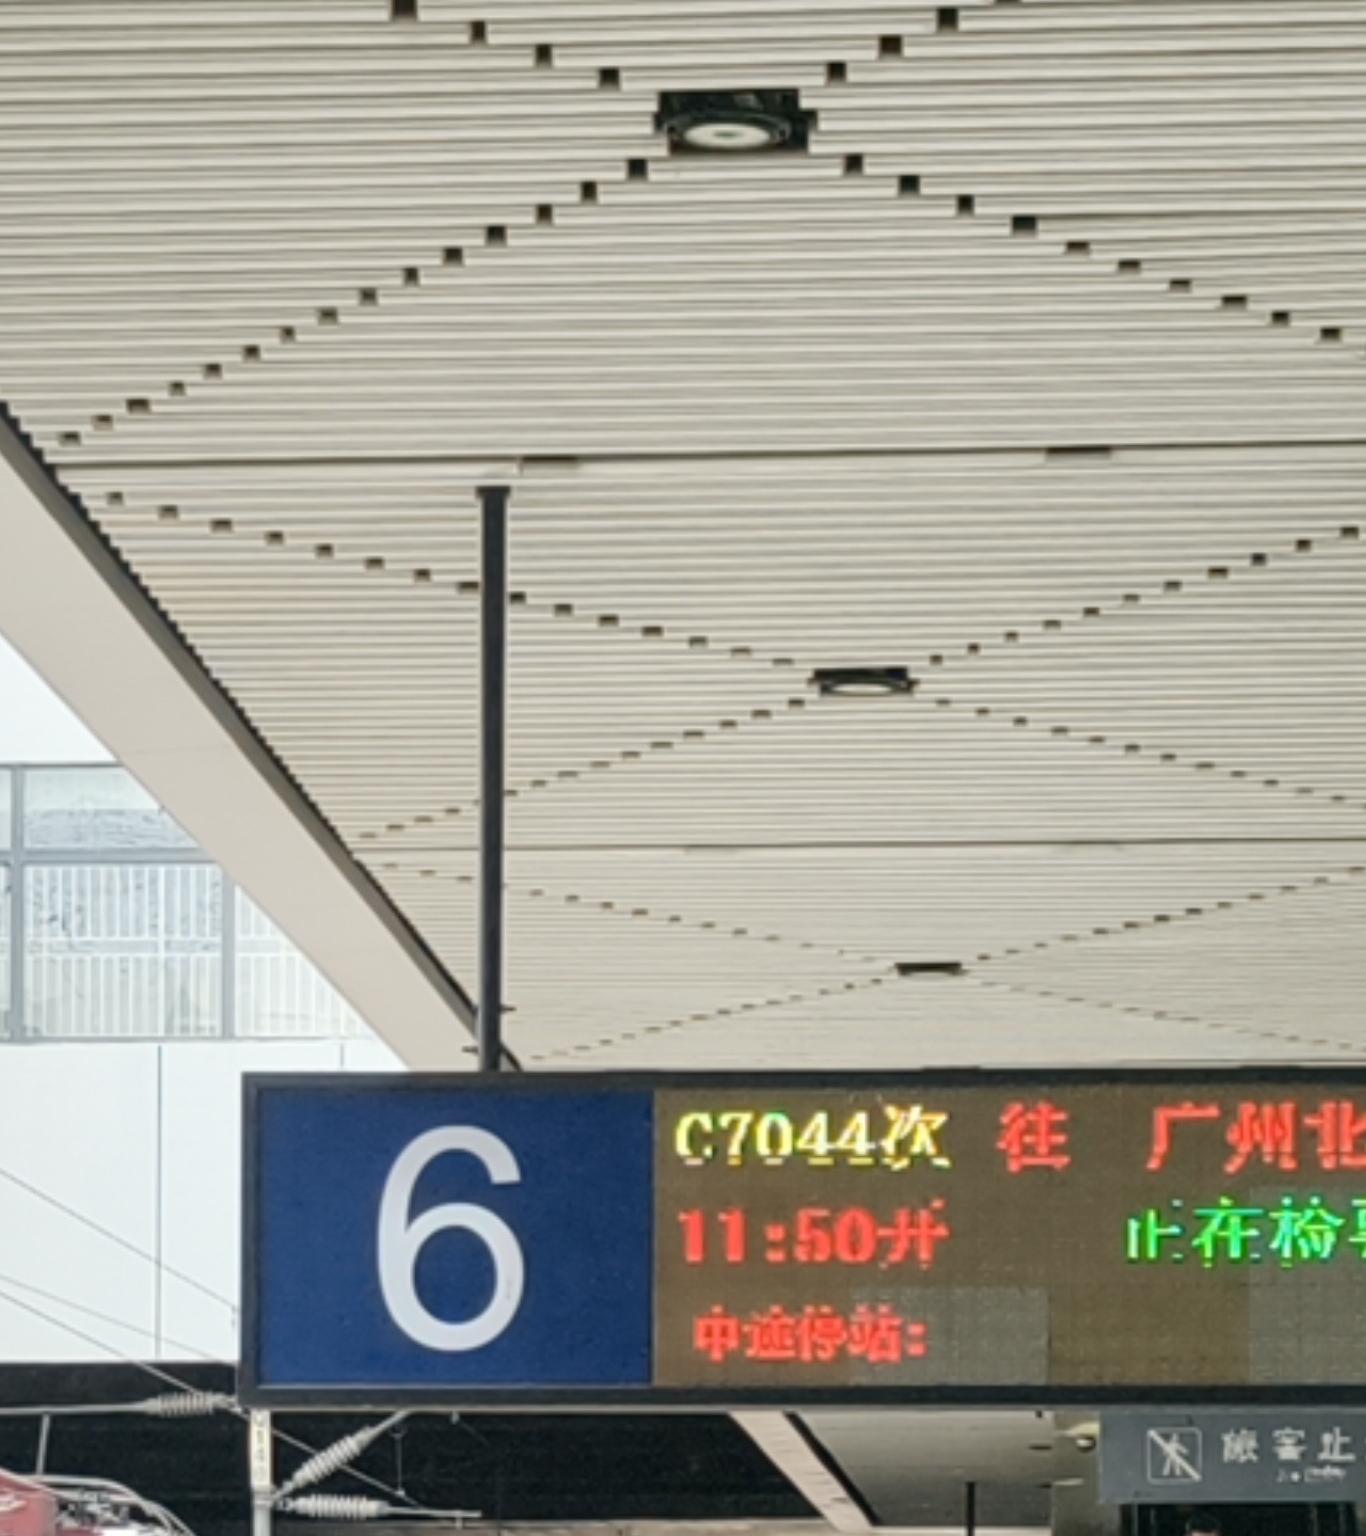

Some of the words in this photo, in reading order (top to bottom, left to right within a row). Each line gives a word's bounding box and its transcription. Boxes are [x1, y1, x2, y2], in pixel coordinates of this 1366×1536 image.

[675, 1104, 951, 1170] C7044次
[996, 1102, 1071, 1173] 往
[377, 1124, 524, 1351] 6
[678, 1199, 949, 1270] 11:50开
